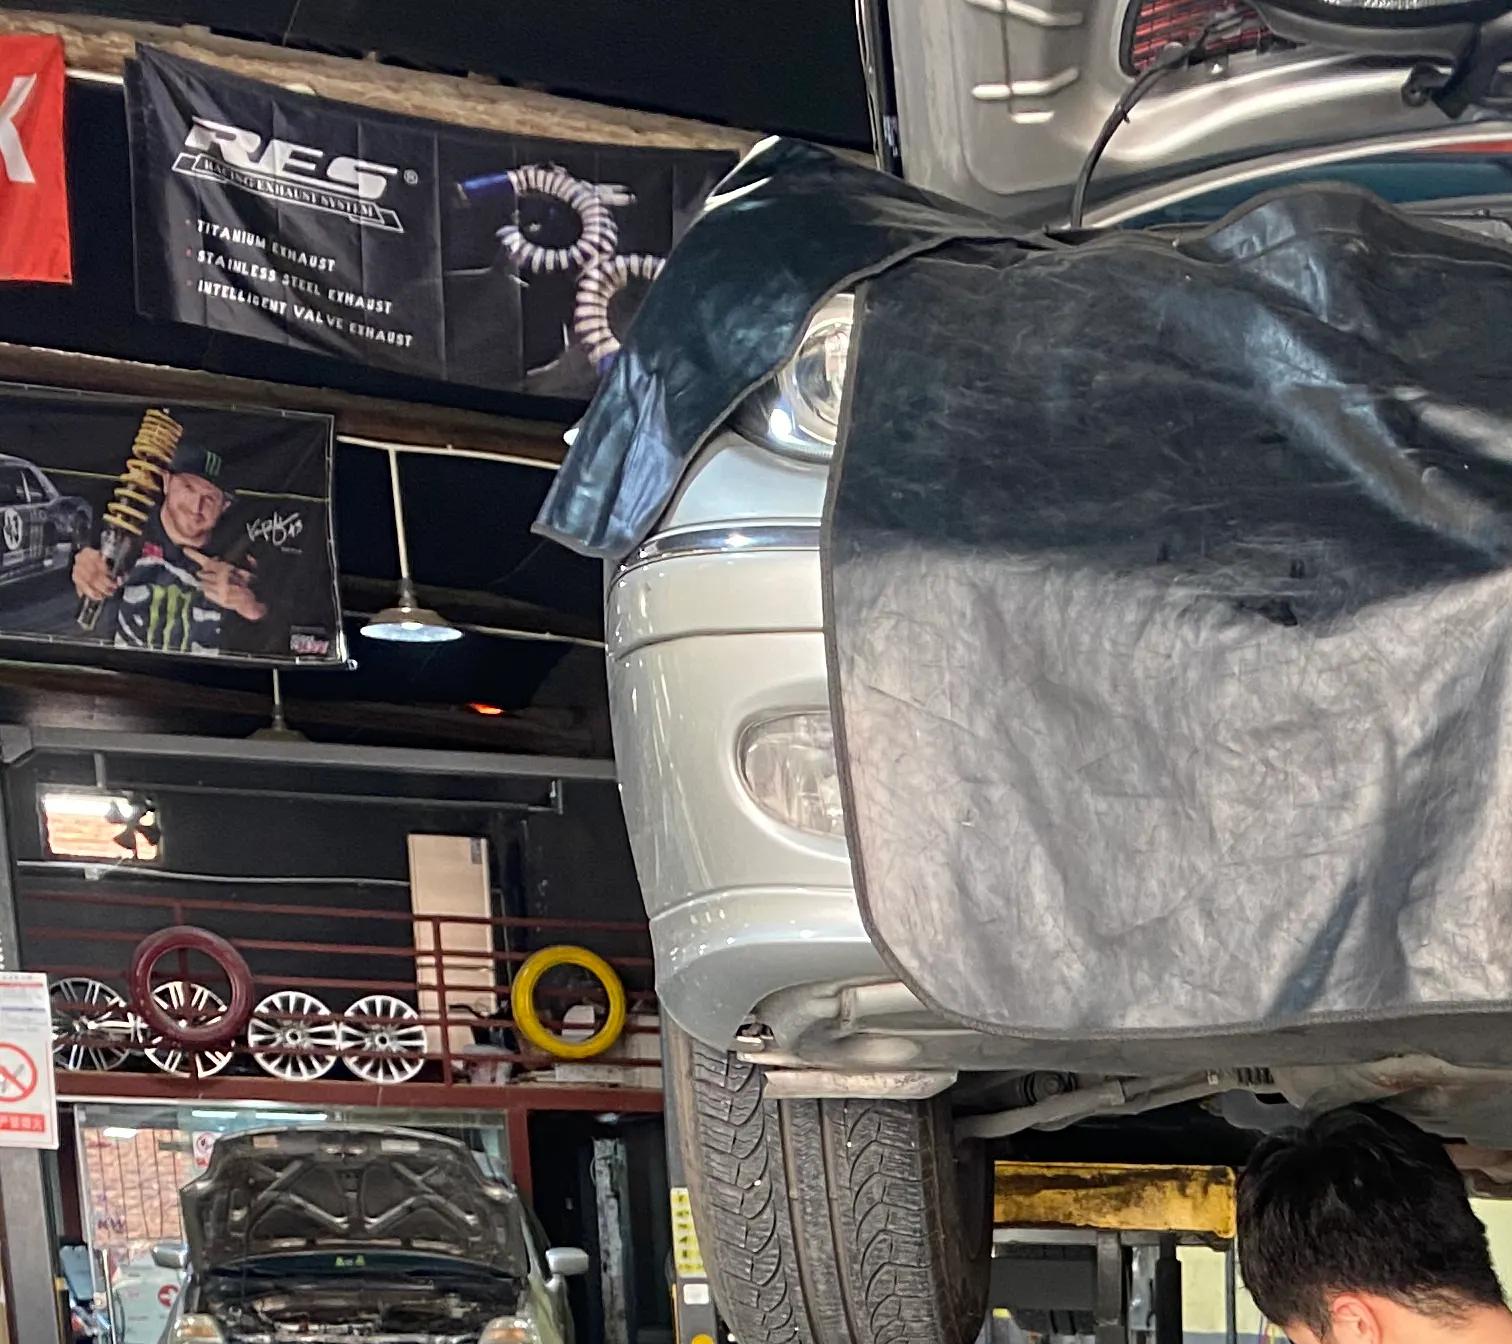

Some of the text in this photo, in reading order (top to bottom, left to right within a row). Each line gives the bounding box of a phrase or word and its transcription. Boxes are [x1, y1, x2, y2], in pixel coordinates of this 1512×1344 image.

[256, 179, 317, 204] EXHAUST
[321, 195, 374, 217] SYSTEM
[197, 219, 336, 272] TITANIUM EXHAUST
[197, 250, 392, 315] STAINLESS STEEL EXHAUST
[197, 280, 413, 348] INTELLIGENT VALVE EXHAUST
